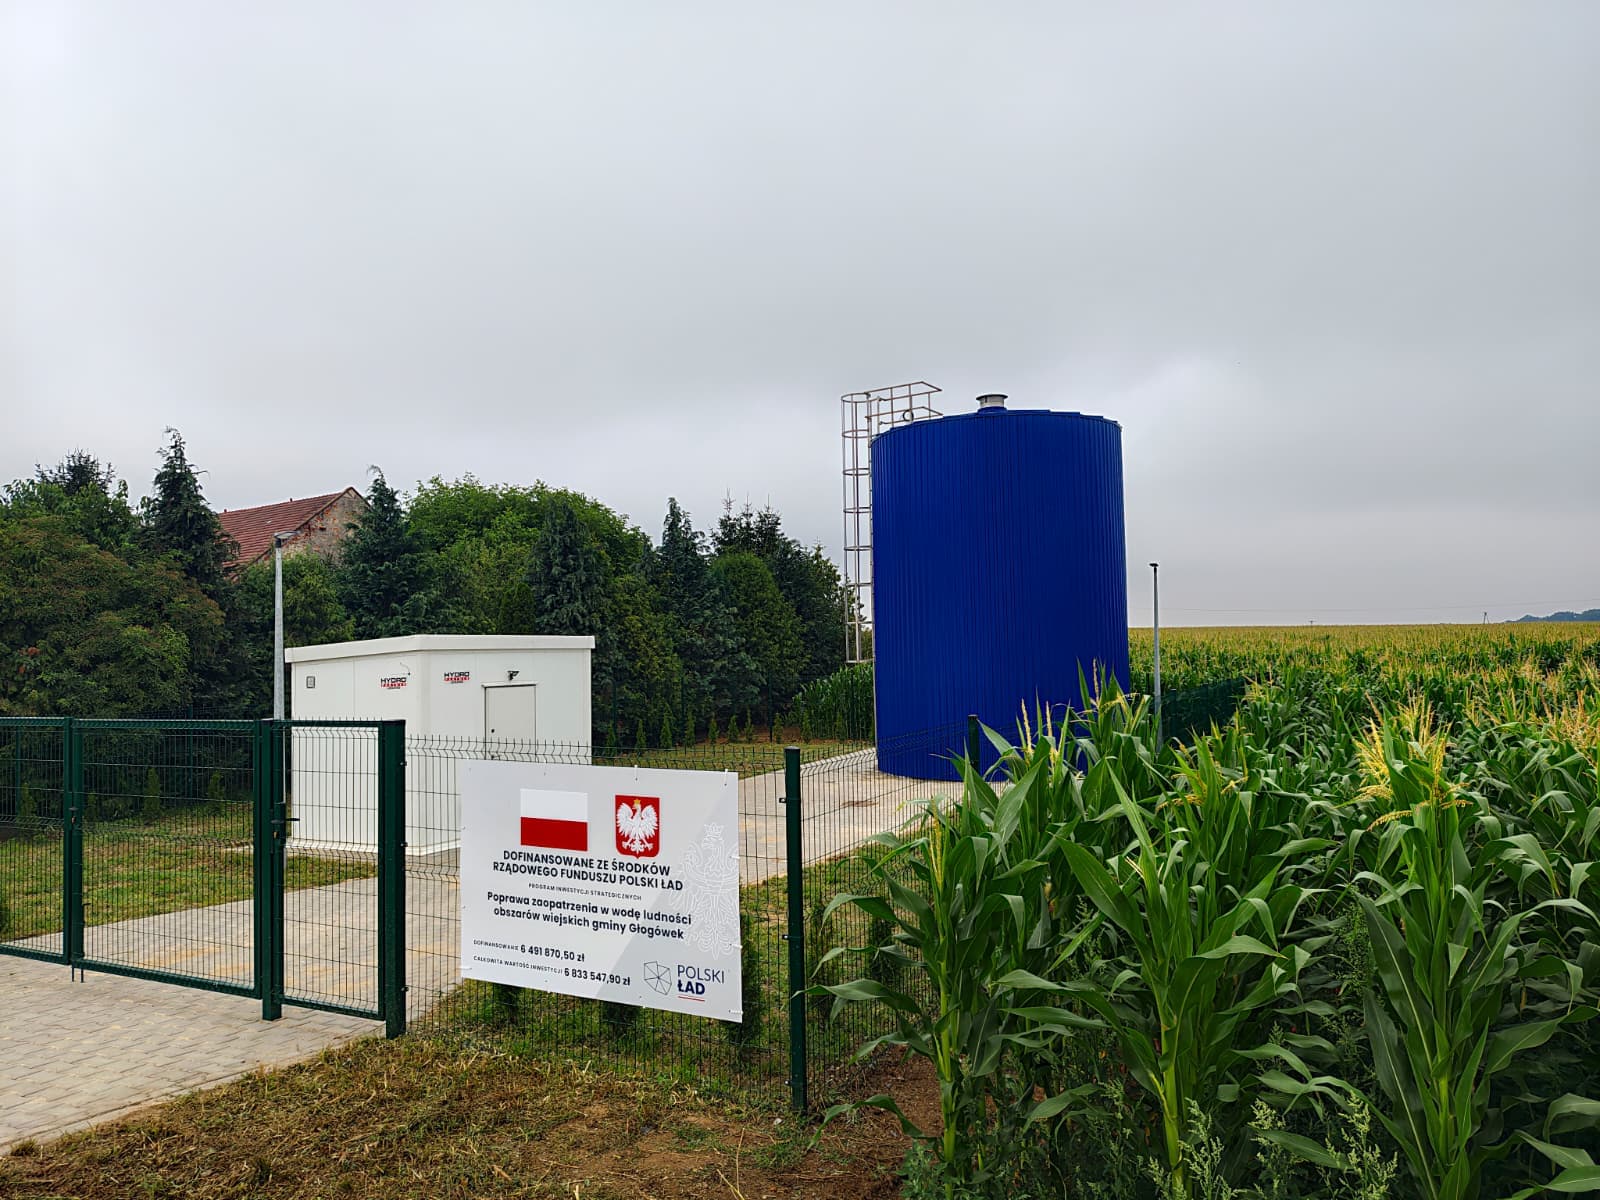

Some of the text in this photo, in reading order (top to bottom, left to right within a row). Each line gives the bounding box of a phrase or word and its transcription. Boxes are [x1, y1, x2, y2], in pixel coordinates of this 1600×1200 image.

[503, 850, 670, 876] DOFINANSOWANE ZE ŚRODKÓW
[493, 861, 684, 891] RZĄDOWEGO FUNDUSZU POLSKI ŁAD
[556, 886, 589, 895] INWESTYCJI
[590, 890, 642, 900] STRATEGICZNYCH
[487, 891, 692, 925] Poprawa zaopatrzenia w wodę ludności
[494, 906, 684, 939] obszarów wiejskich gminy Głogówek
[520, 944, 526, 953] 6
[528, 945, 542, 956] 491
[544, 948, 575, 960] 870,50
[577, 953, 585, 962] zł
[564, 967, 570, 977] 6
[571, 969, 588, 980] 833
[590, 972, 621, 985] 547,90
[622, 976, 631, 986] zł
[677, 964, 725, 984] POLSKI
[677, 980, 706, 995] ŁAD
